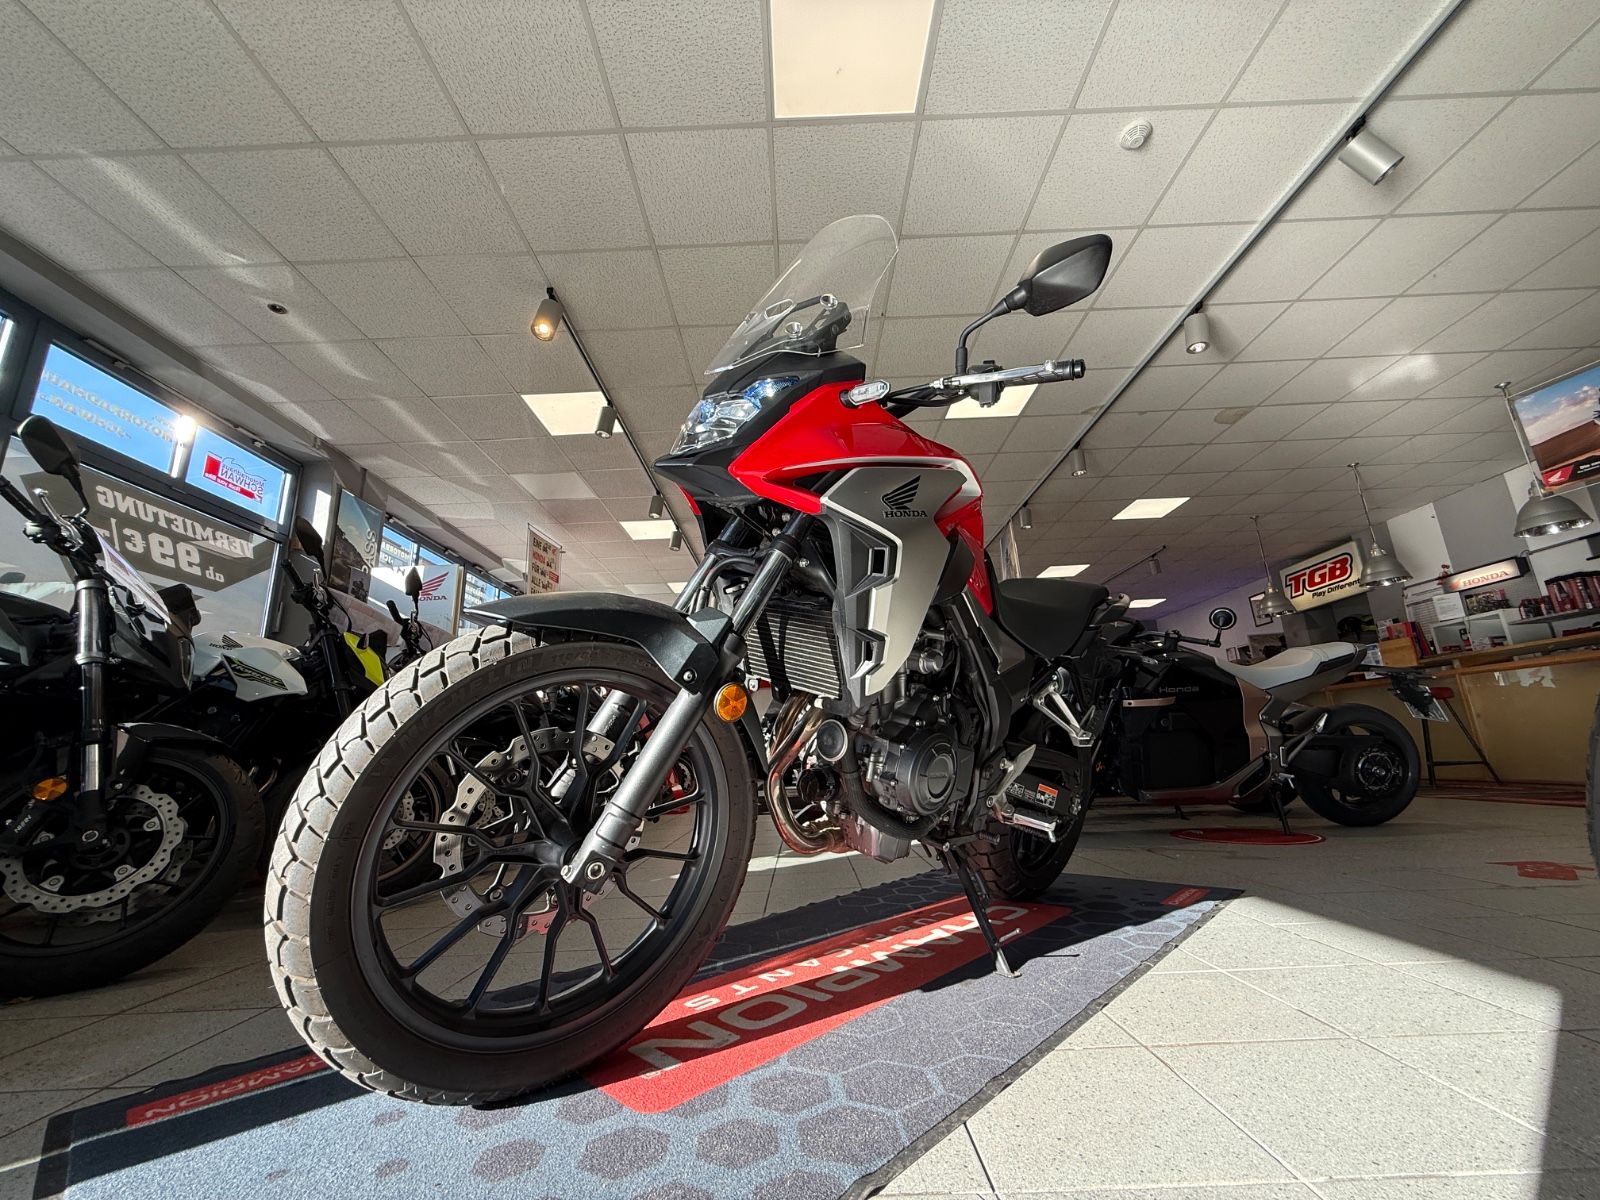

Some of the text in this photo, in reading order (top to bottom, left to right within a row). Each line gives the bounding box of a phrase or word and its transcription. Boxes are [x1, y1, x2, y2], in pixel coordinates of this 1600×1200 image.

[884, 510, 928, 518] HONDA
[1287, 555, 1351, 597] TGB
[1312, 577, 1361, 599] Play Different
[1463, 570, 1510, 587] HONDA
[684, 911, 953, 1012] LUBRICANTS
[145, 1060, 323, 1118] HAMPION
